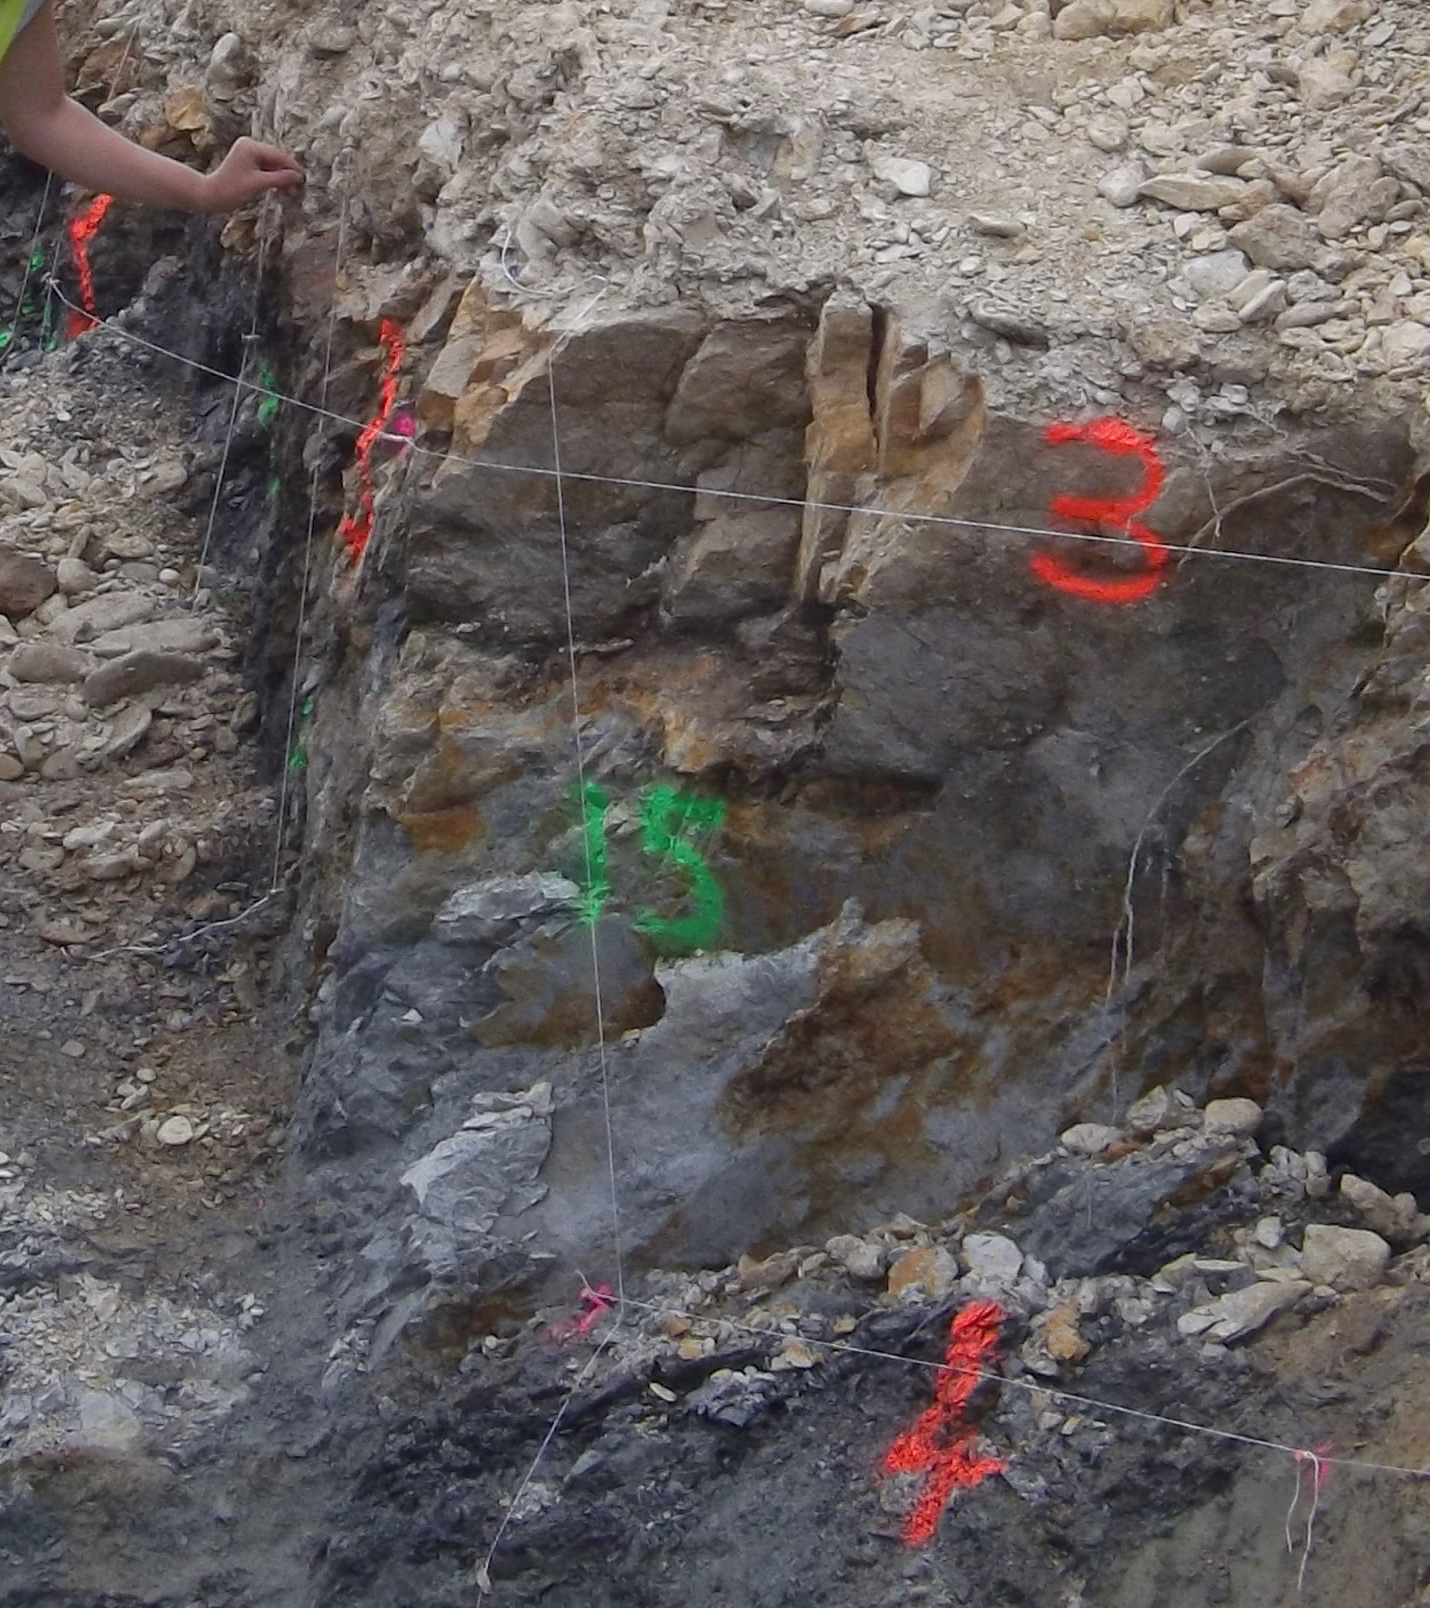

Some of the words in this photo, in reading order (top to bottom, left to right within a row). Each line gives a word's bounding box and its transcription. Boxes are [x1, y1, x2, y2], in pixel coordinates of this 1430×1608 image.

[1030, 416, 1168, 605] 3
[573, 776, 729, 954] 15
[882, 1298, 1009, 1549] 4
